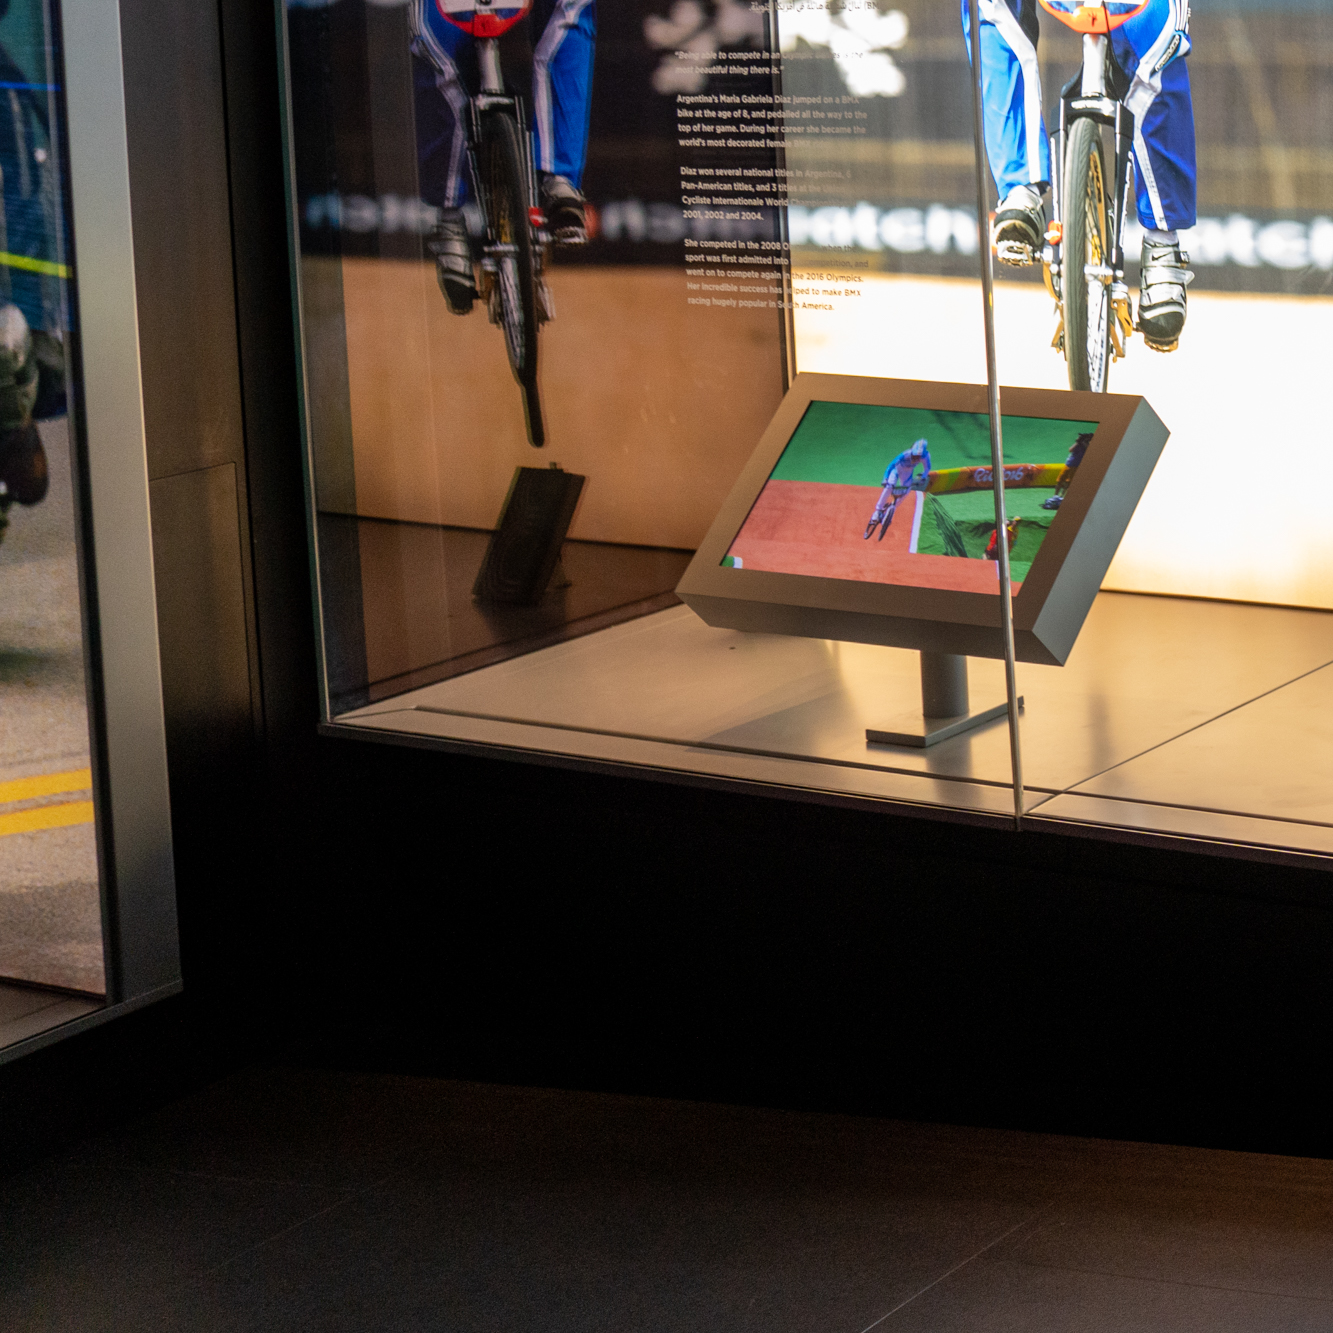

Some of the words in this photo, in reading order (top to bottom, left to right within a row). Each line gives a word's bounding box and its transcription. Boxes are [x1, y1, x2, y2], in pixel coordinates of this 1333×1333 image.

[719, 95, 740, 104] Maria
[742, 95, 773, 104] Gabriela
[774, 95, 791, 104] Diaz
[677, 109, 694, 118] bike
[695, 110, 703, 118] at
[704, 109, 716, 118] the
[718, 111, 731, 120] age
[733, 109, 741, 118] of
[751, 110, 766, 118] and
[767, 110, 800, 120] pedalled
[681, 182, 732, 191] Pan-American
[756, 183, 770, 192] and
[772, 183, 777, 192] 3
[682, 196, 711, 206] Cycliste
[713, 196, 764, 206] Internationale
[765, 197, 788, 206] World
[704, 211, 725, 219] 2002
[726, 211, 740, 220] and
[688, 297, 711, 307] racing
[712, 297, 737, 308] hugely
[739, 298, 767, 309] popular
[769, 299, 776, 308] in
[802, 301, 835, 311] America.
